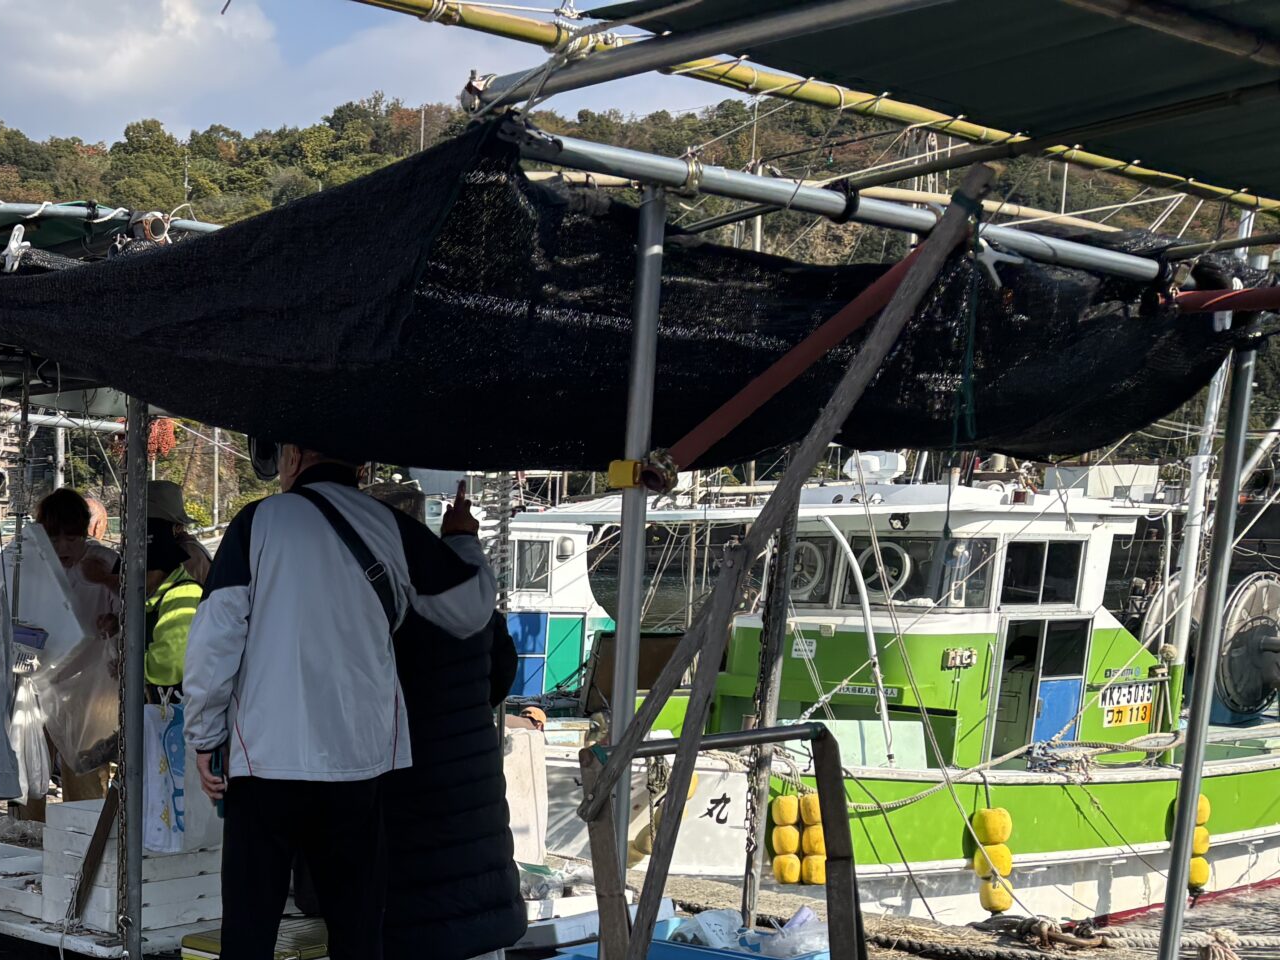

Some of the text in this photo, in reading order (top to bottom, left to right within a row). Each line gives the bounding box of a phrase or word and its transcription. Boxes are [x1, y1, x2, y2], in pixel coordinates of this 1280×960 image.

[1100, 683, 1153, 707] WK2-5035
[1106, 706, 1148, 724] ワカ 113
[698, 792, 731, 825] 丸
